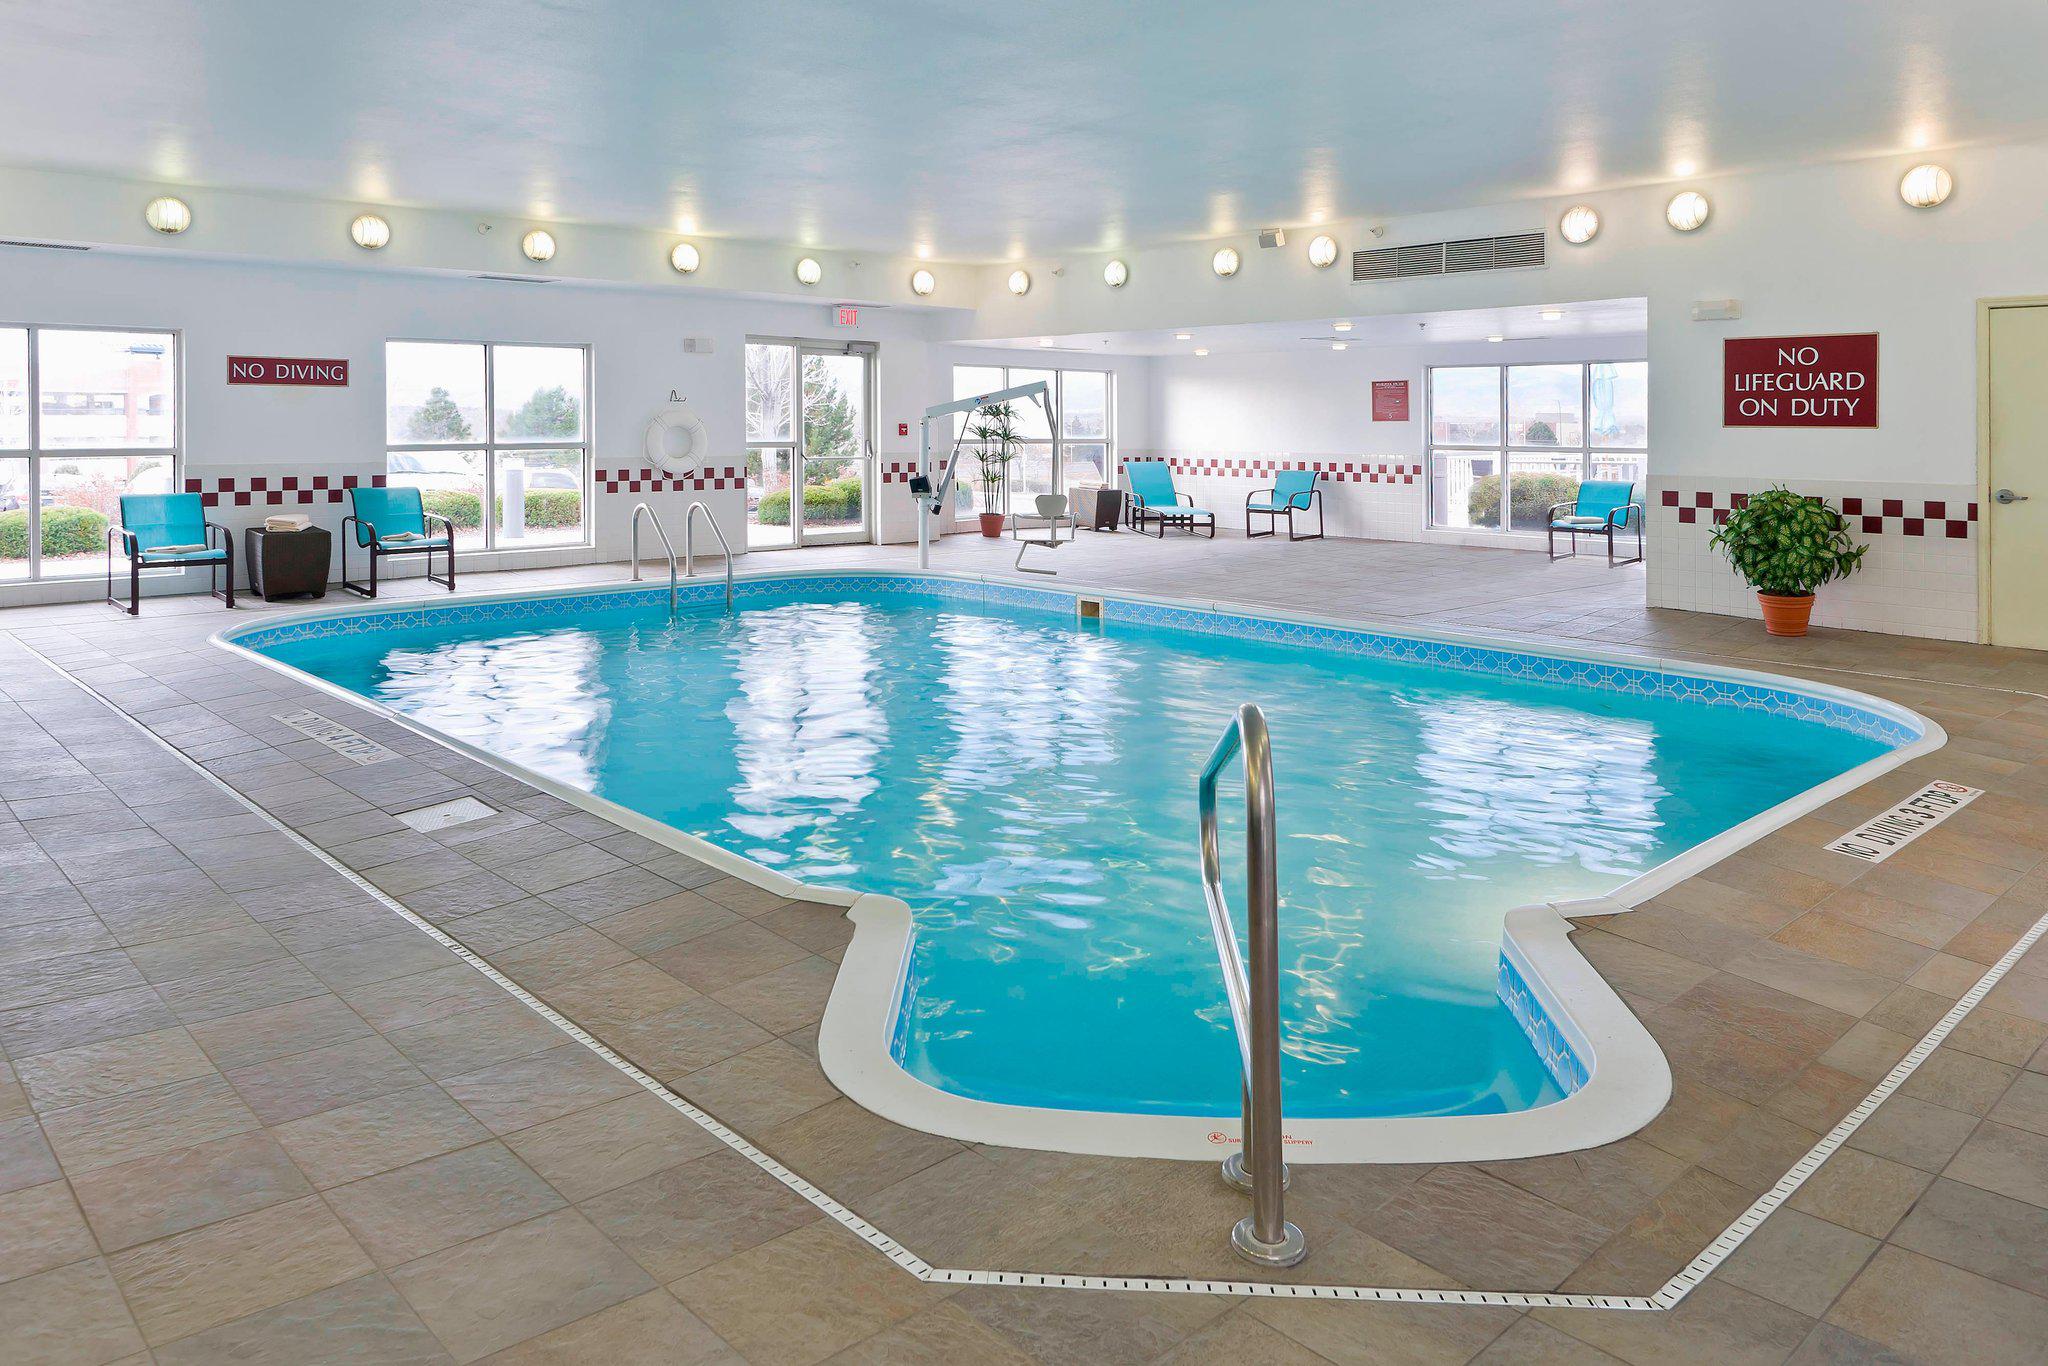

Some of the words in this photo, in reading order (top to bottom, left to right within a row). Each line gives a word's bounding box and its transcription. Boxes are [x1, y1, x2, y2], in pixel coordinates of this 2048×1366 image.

[839, 309, 857, 325] EXIT
[1778, 346, 1819, 366] NO
[232, 363, 265, 379] NO
[276, 364, 344, 380] DIVING
[1735, 372, 1865, 392] LIFEGUARD
[1739, 398, 1778, 417] ON
[1791, 398, 1860, 417] DUTY
[1898, 808, 1936, 820] 3
[1855, 814, 1925, 846] DIVING
[1833, 842, 1880, 860] NO
